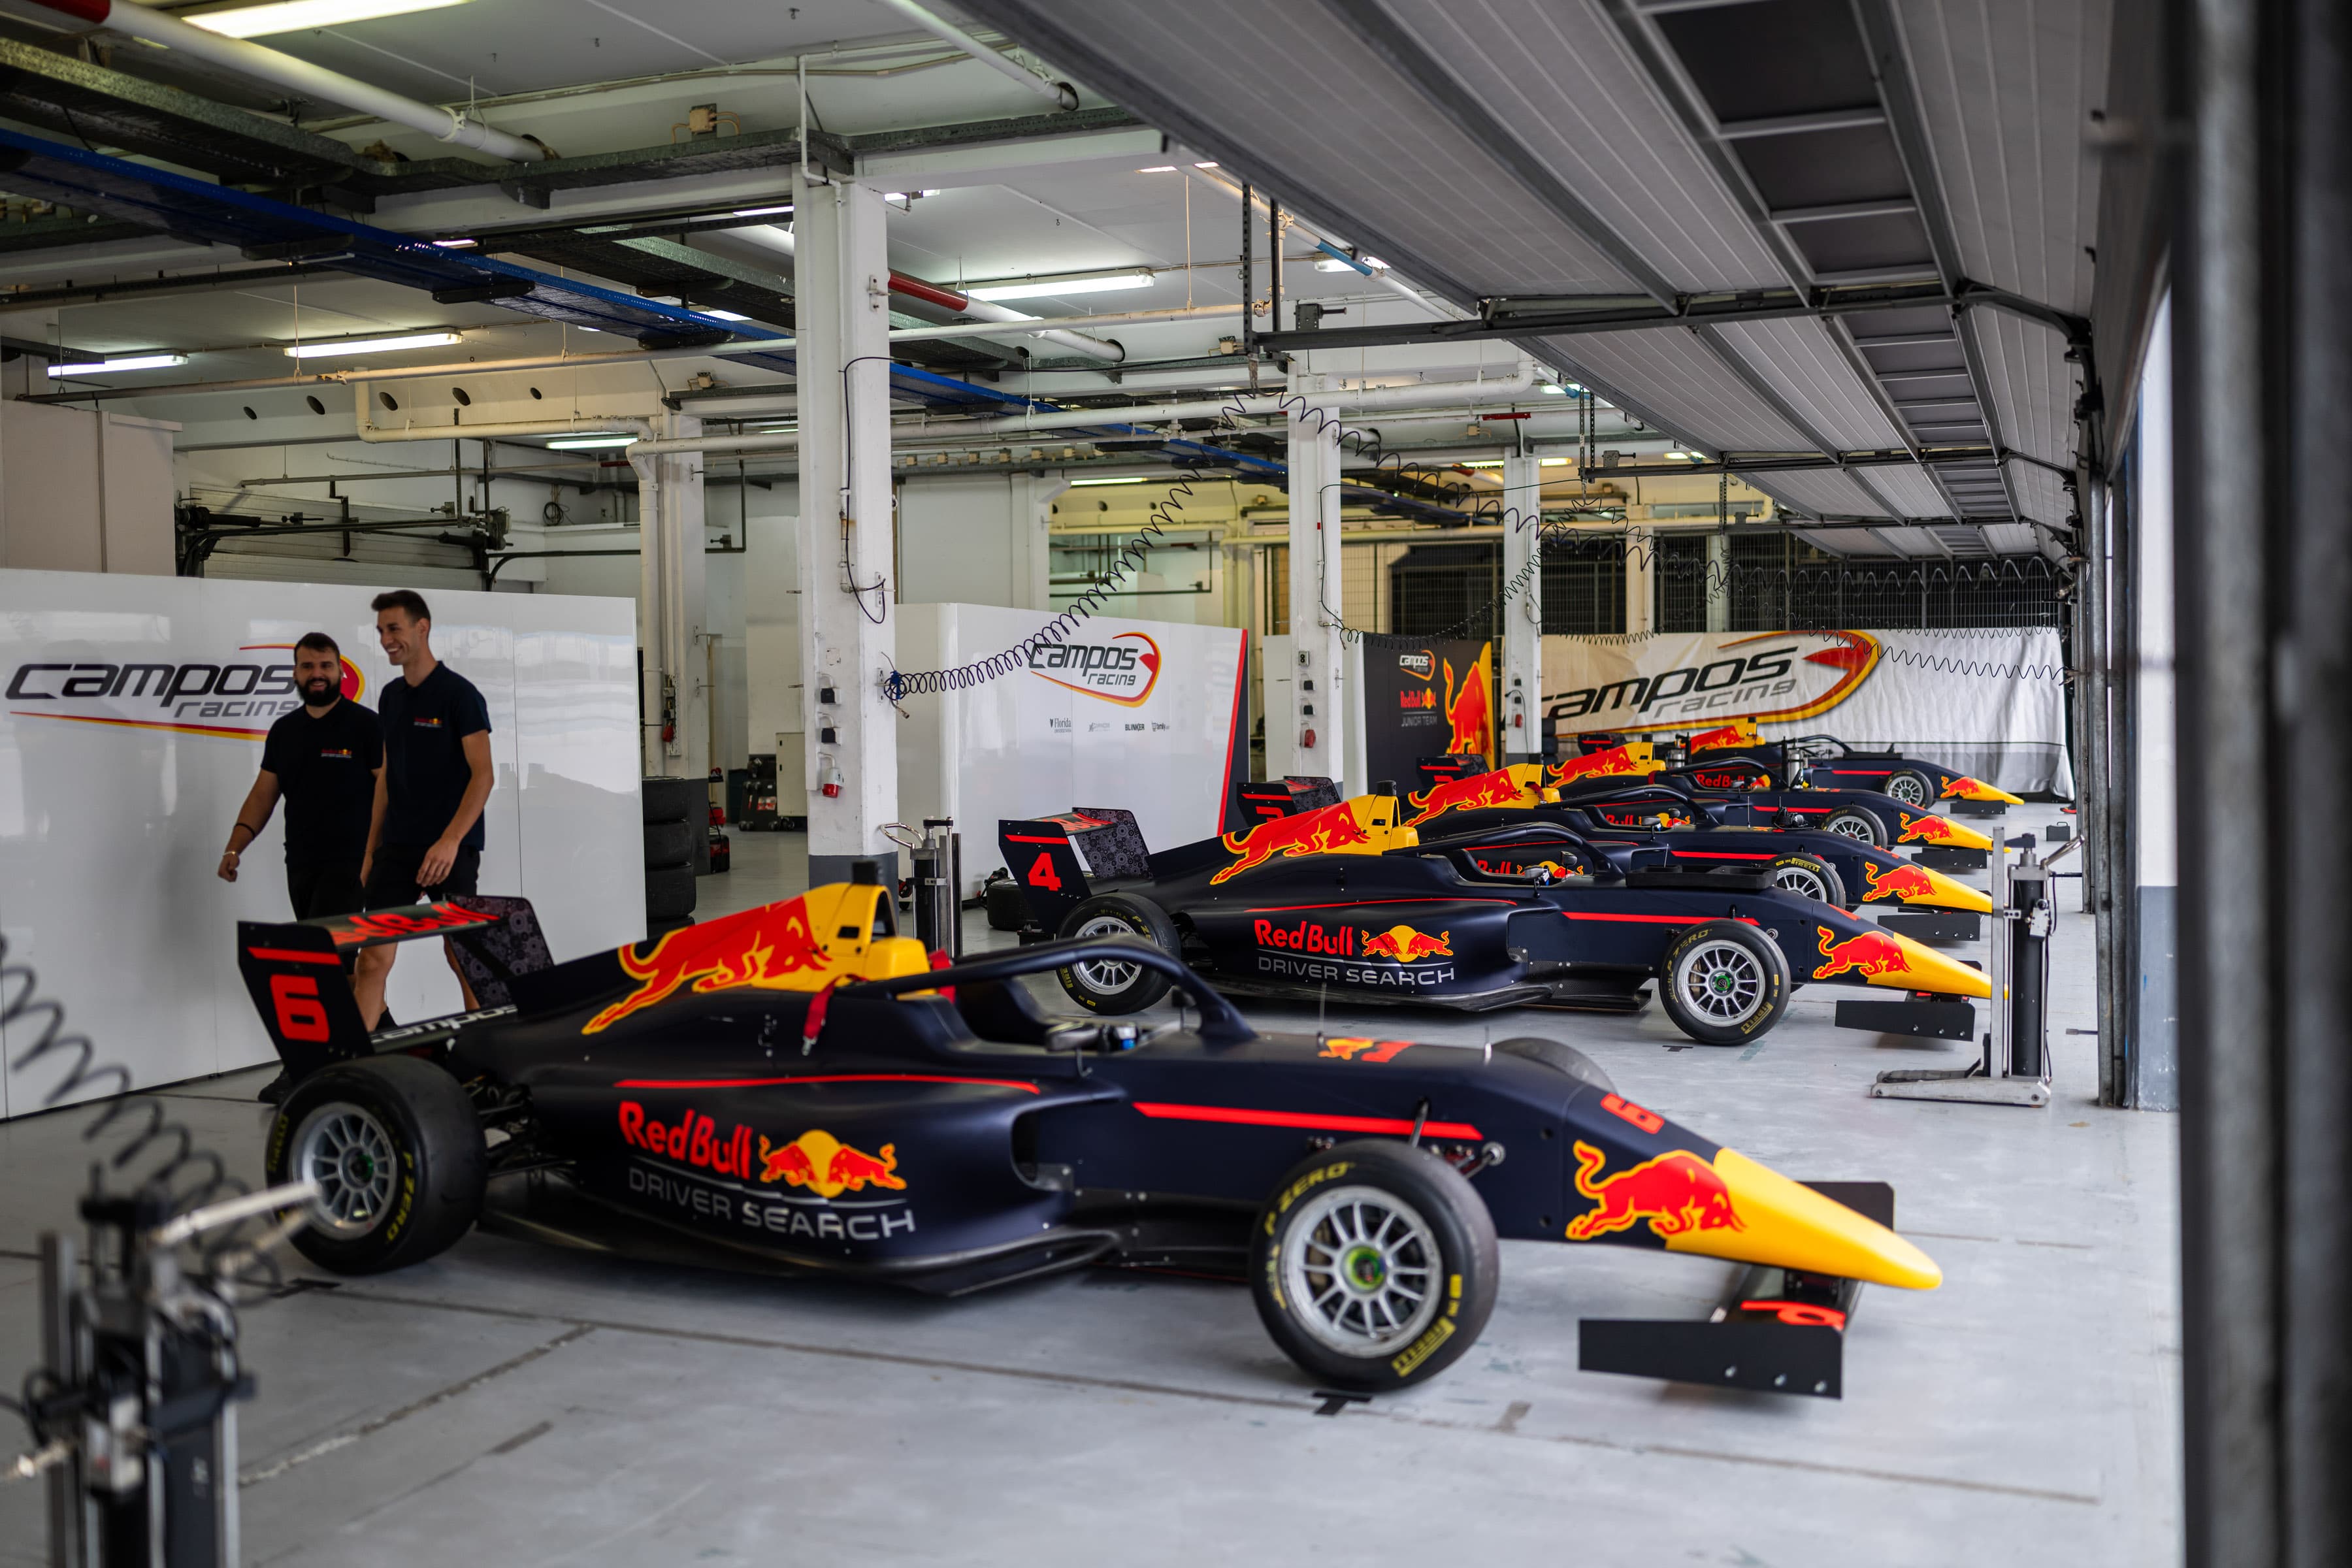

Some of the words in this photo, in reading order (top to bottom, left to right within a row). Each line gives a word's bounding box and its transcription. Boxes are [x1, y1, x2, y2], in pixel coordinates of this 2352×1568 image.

[1087, 673, 1136, 686] racing
[1541, 646, 1799, 719] ampos
[174, 700, 299, 718] racing
[1654, 679, 1797, 719] racing
[1054, 717, 1071, 728] Florida
[1125, 723, 1145, 732] BLINKER
[1028, 852, 1062, 891] 4
[1791, 857, 1821, 872] PIRELLI
[1673, 928, 1709, 958] ZERO
[1258, 956, 1338, 981] DRIVER
[1346, 968, 1455, 986] SEARCH
[269, 973, 330, 1043] 6
[1740, 1002, 1774, 1035] PIRELLI
[1600, 1092, 1665, 1134] 6
[403, 1151, 414, 1169] P
[387, 1177, 415, 1241] ZERO
[629, 1166, 732, 1220] DRIVER
[742, 1201, 916, 1240] SEARCH
[1264, 1211, 1276, 1237] P
[1278, 1160, 1350, 1213] ZERO
[1391, 1316, 1456, 1377] PIRELLI
